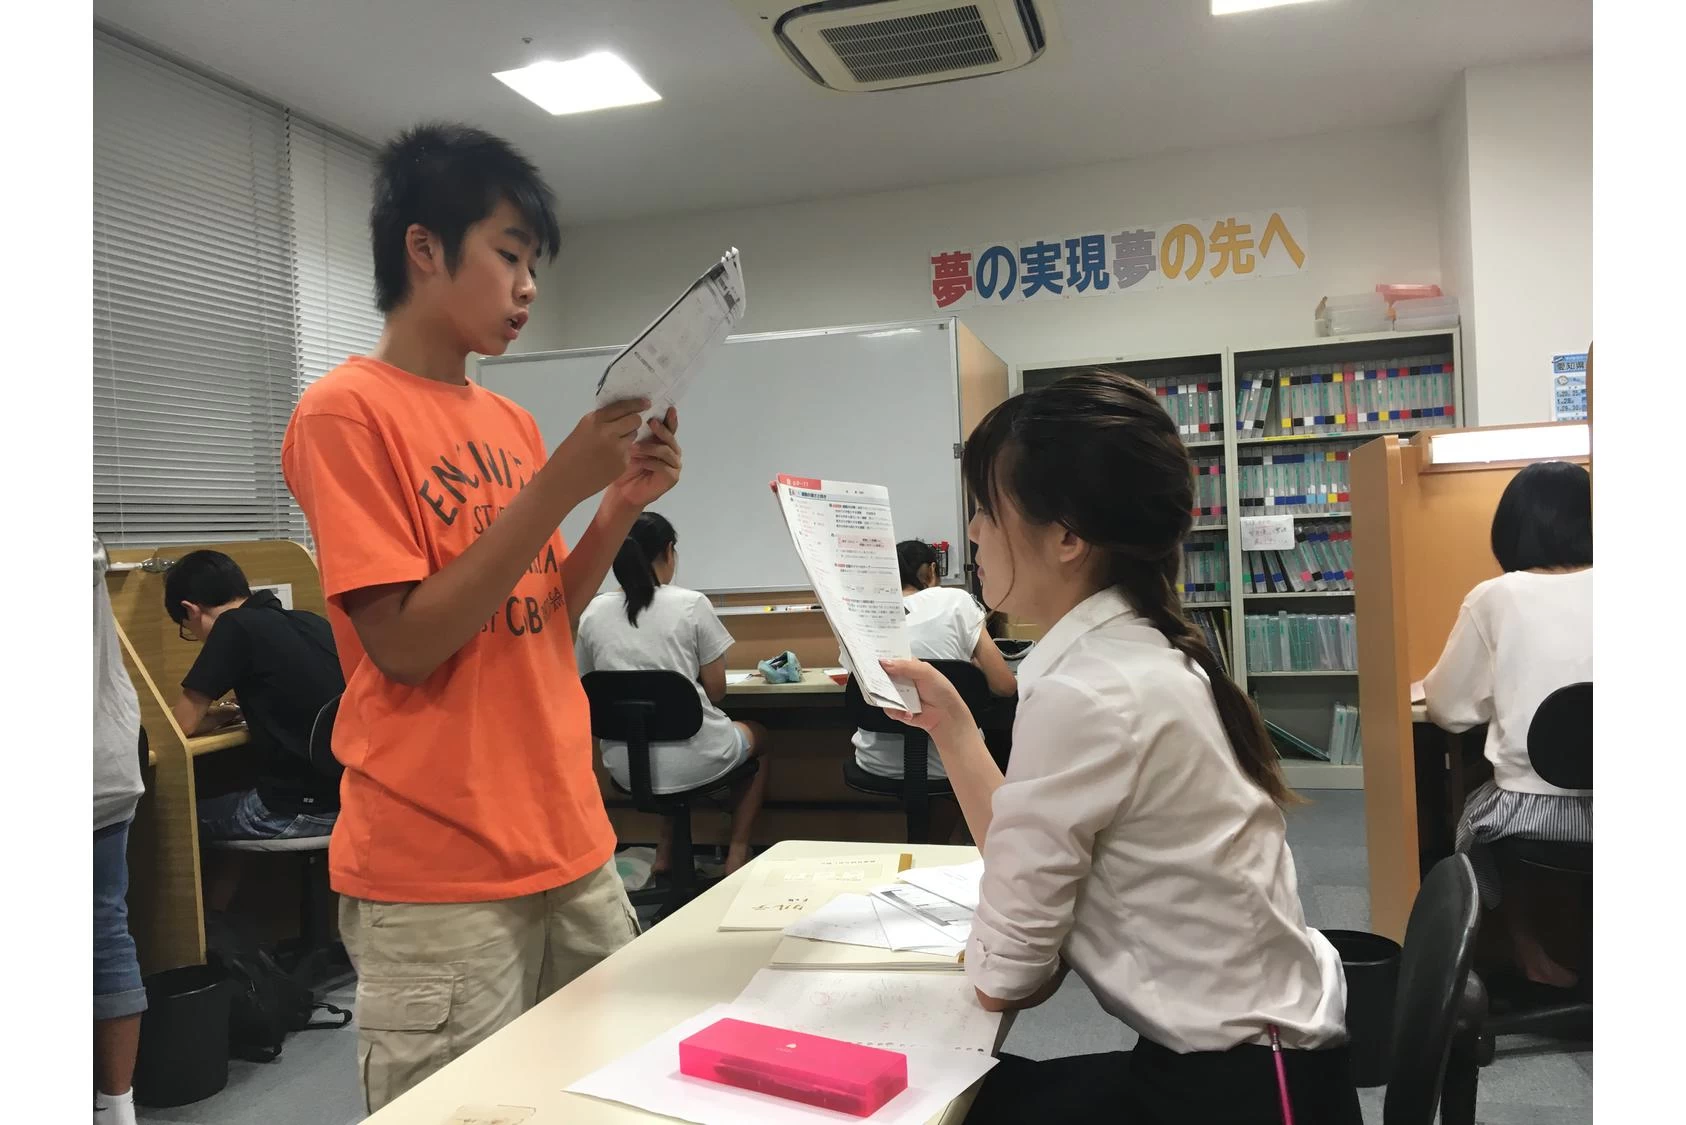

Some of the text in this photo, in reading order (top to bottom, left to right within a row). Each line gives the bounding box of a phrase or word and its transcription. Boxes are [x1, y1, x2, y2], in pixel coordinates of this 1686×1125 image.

[931, 212, 1306, 309] 夢の実現夢の先へ
